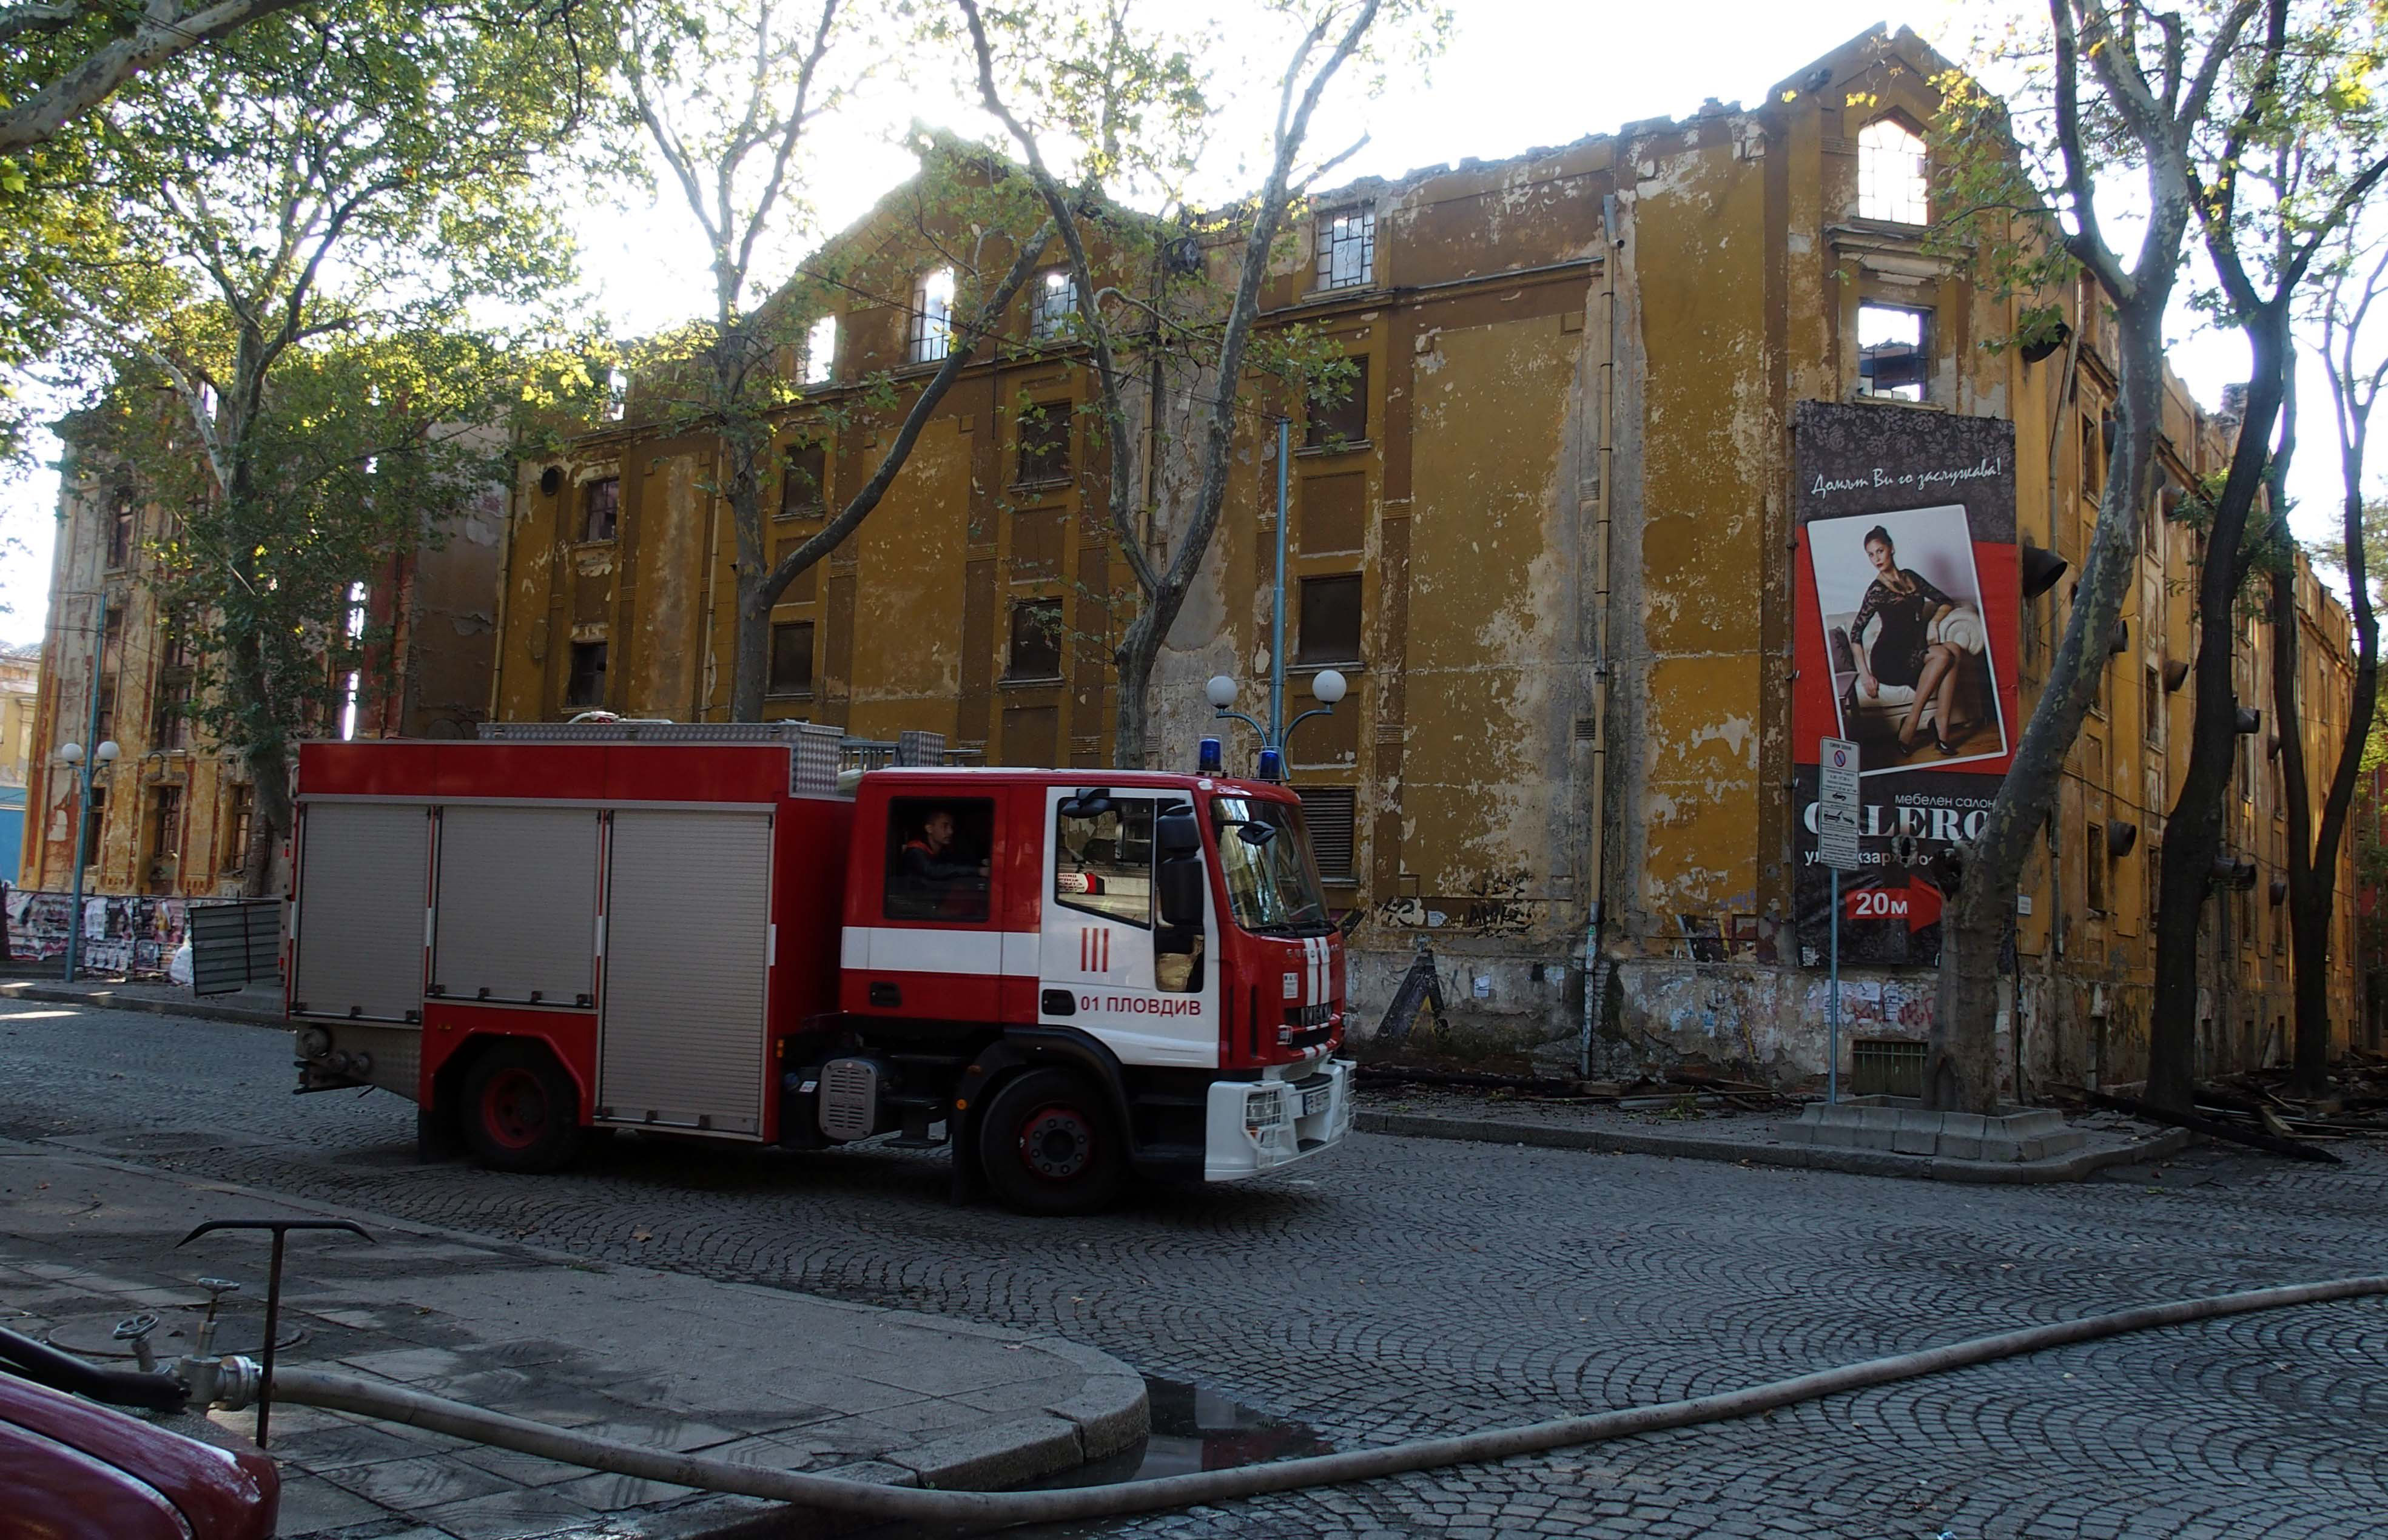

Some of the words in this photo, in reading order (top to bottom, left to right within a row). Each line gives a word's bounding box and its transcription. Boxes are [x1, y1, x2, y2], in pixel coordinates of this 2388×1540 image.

[1811, 474, 1868, 499] Домът
[1872, 468, 1893, 488] Ви
[1897, 474, 1913, 485] го
[1917, 456, 2002, 490] заслужава!
[1894, 793, 1952, 807] мебелен
[1955, 797, 1994, 809] салон
[1855, 892, 1908, 915] 20м
[1080, 996, 1099, 1011] 01
[1106, 997, 1202, 1018] ПЛОВДИВ
